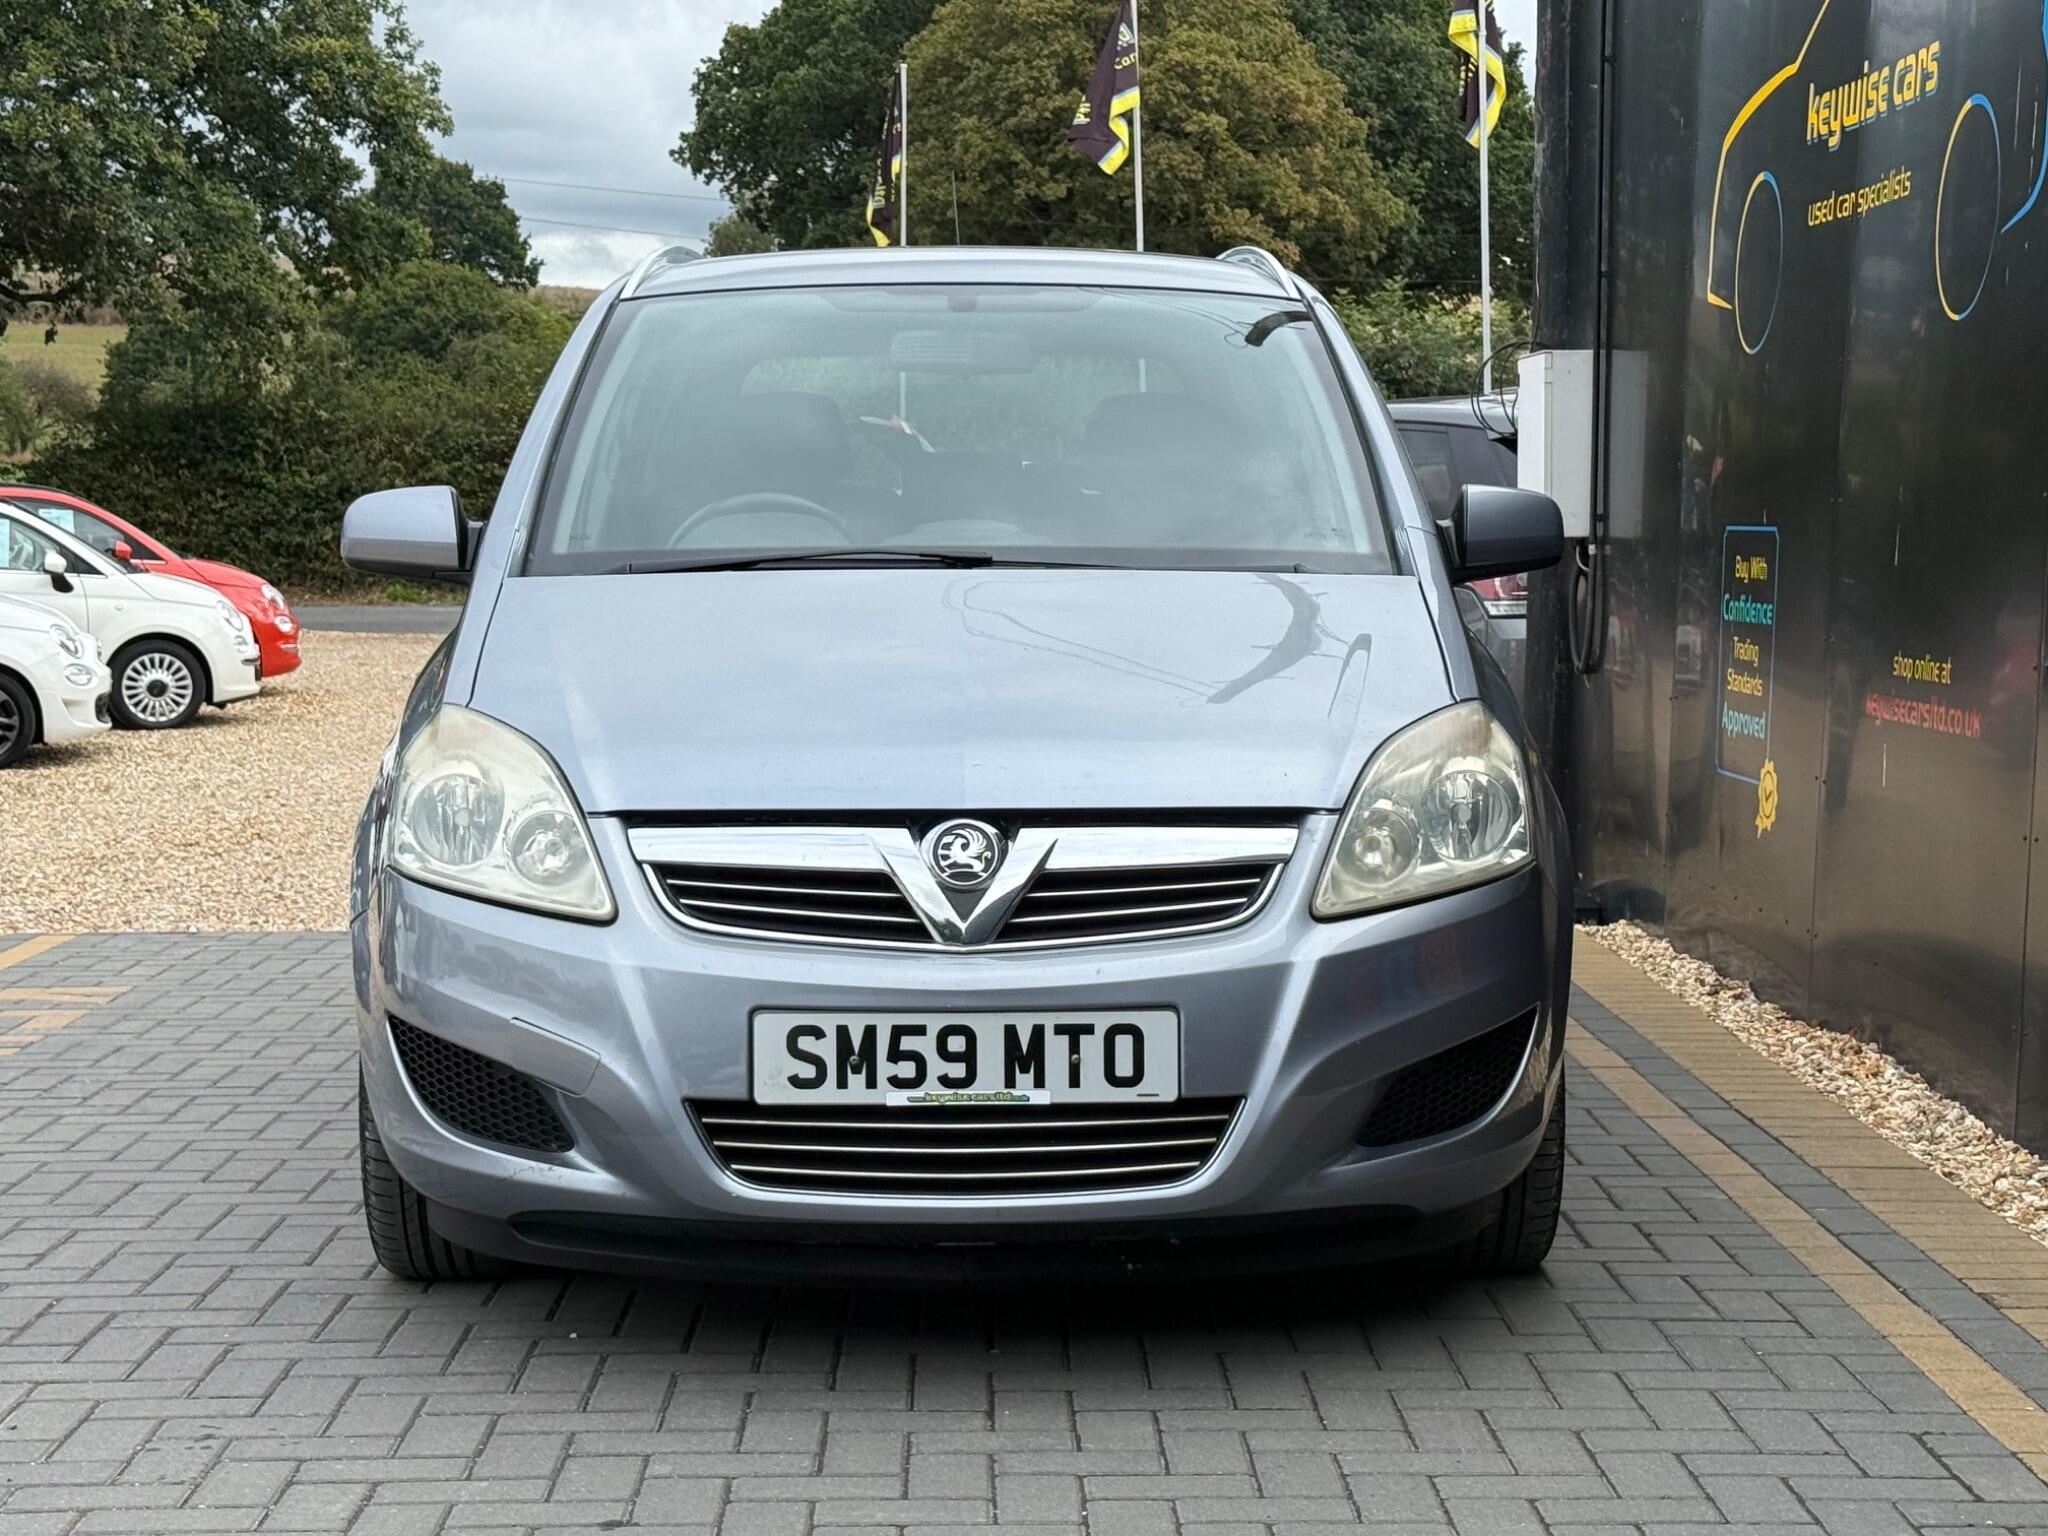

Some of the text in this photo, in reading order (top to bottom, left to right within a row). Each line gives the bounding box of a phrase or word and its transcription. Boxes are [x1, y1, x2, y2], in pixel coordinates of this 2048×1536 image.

[1807, 40, 1940, 152] keywise cars
[1808, 165, 1911, 226] used car specialists
[1735, 555, 1767, 583] Buy With
[1723, 593, 1773, 625] Confidence
[1733, 636, 1759, 667] Trading
[1893, 650, 1952, 684] shop online at
[1727, 667, 1763, 696] Standards
[1722, 701, 1766, 739] Approved
[786, 1023, 1145, 1090] SM59 MTO
